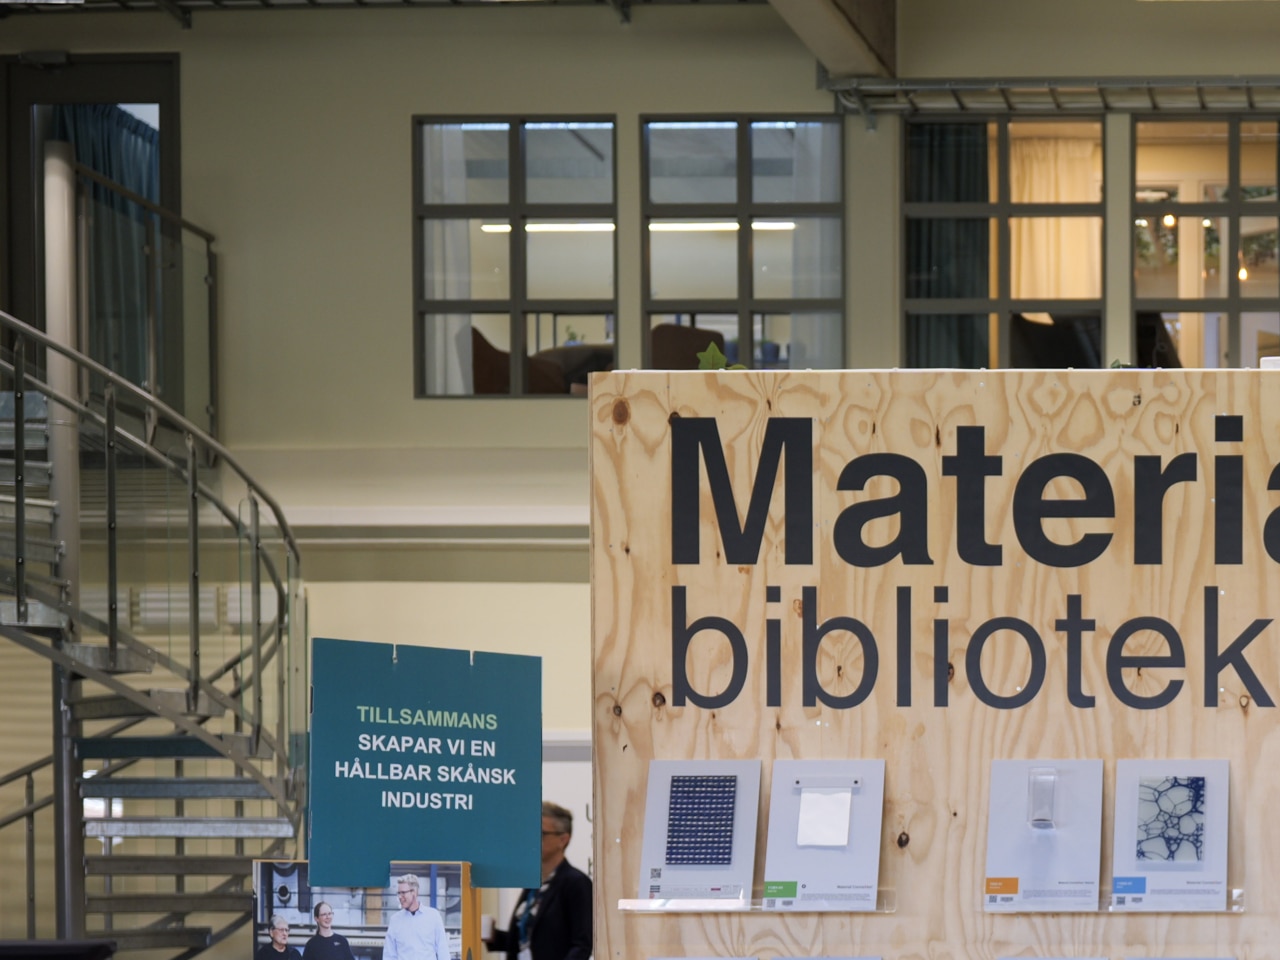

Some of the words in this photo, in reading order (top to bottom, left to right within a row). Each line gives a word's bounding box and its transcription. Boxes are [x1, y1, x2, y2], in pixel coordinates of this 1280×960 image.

[357, 705, 498, 730] TILLSAMMANS
[358, 734, 442, 754] SKAPAR
[447, 738, 465, 756] VI
[471, 740, 496, 757] EN
[335, 757, 432, 781] HÅLLBAR
[437, 762, 516, 785] SKÅNSK
[381, 791, 473, 810] INDUSTRI
